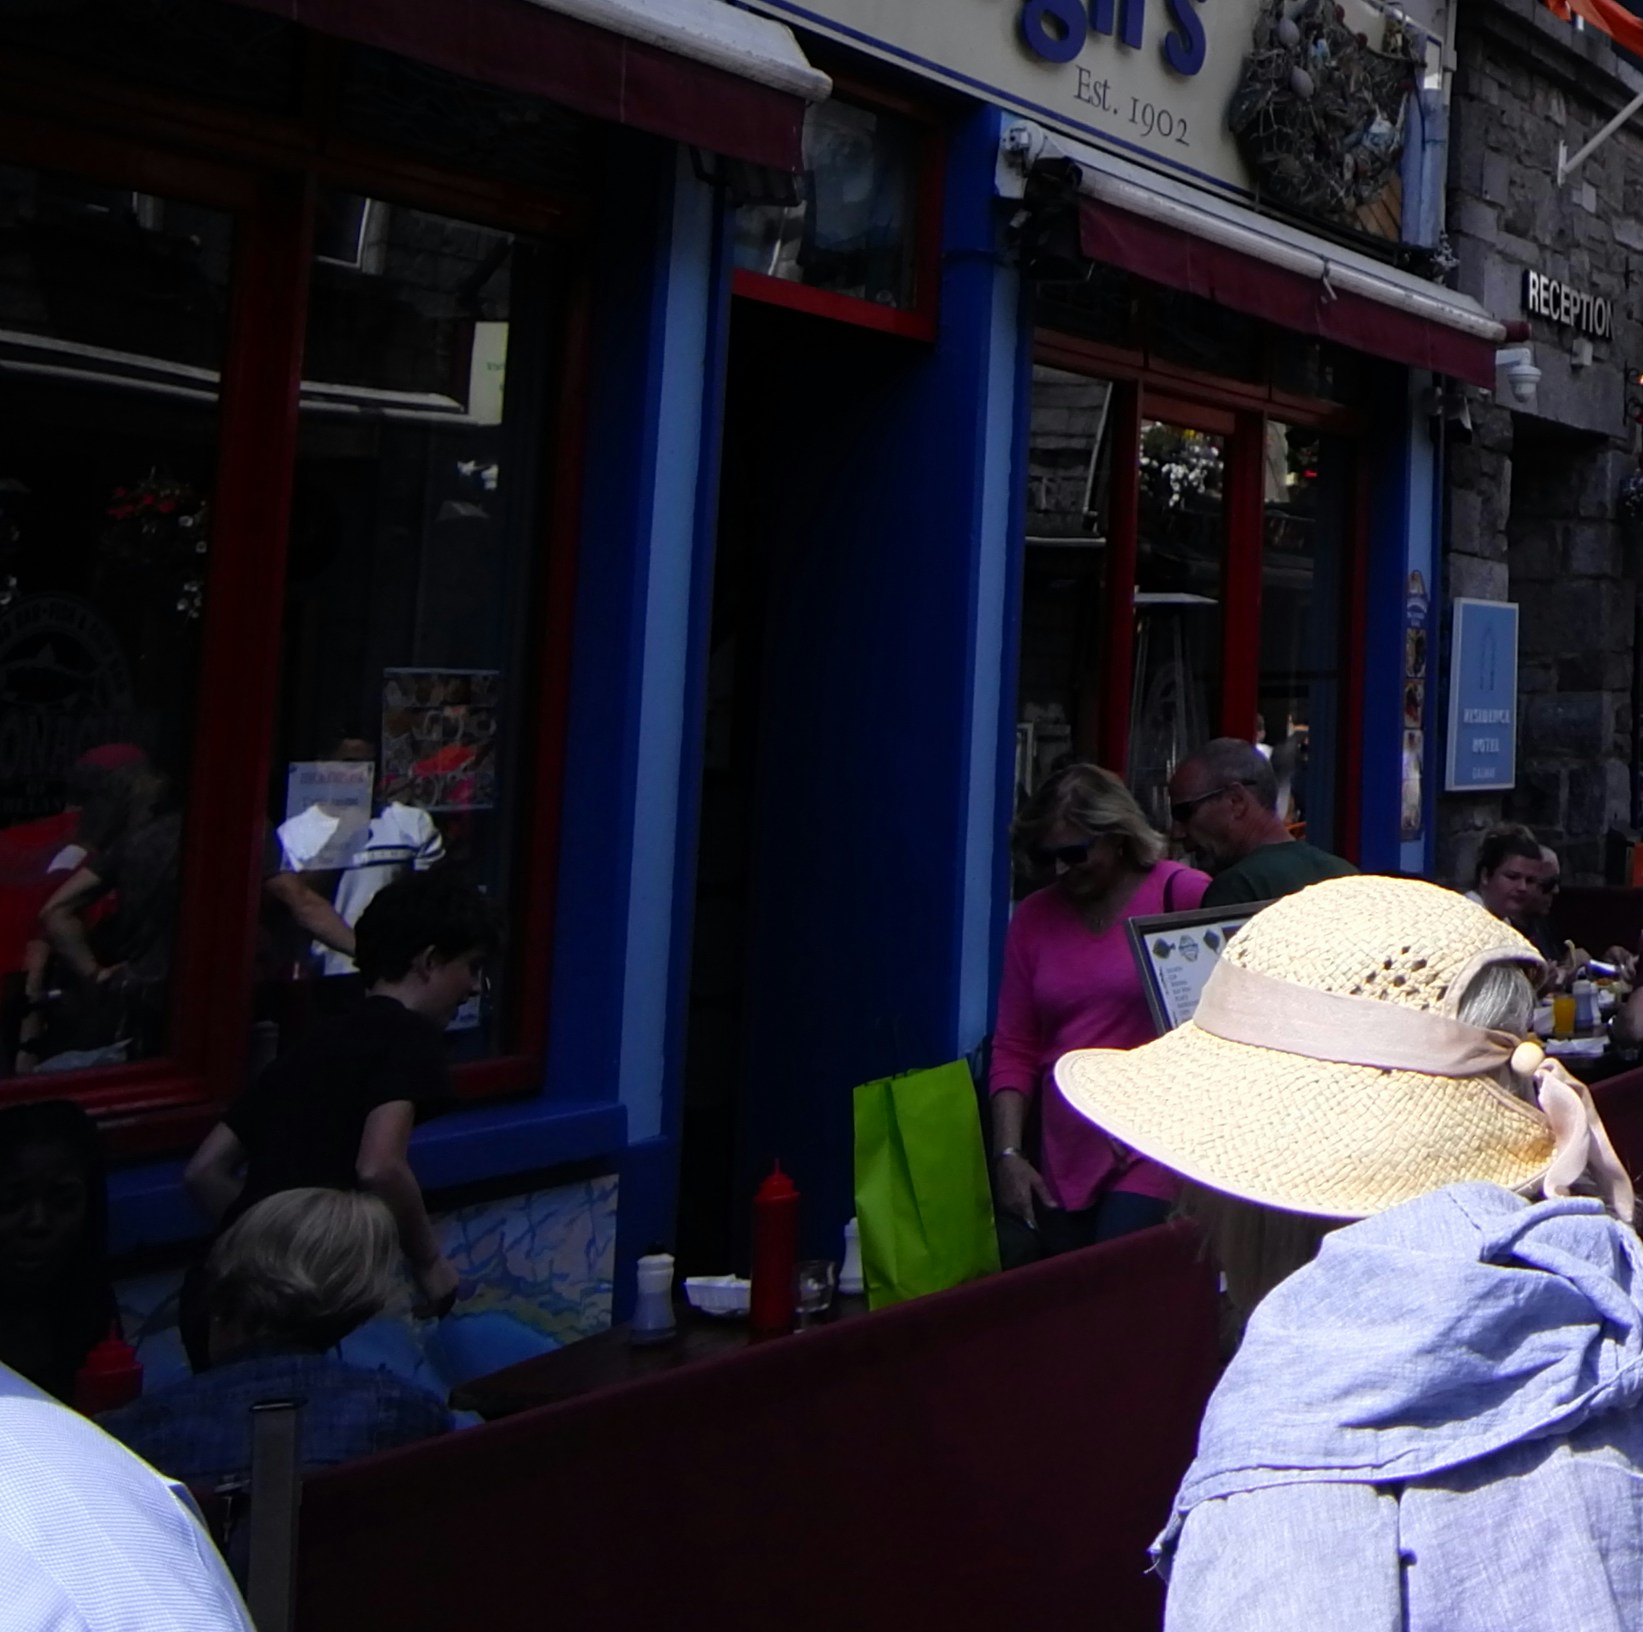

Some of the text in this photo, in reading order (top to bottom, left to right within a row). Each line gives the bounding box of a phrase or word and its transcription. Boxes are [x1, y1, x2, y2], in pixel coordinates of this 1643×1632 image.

[1073, 65, 1191, 147] Est. 1902
[1529, 269, 1615, 340] RECEPTION
